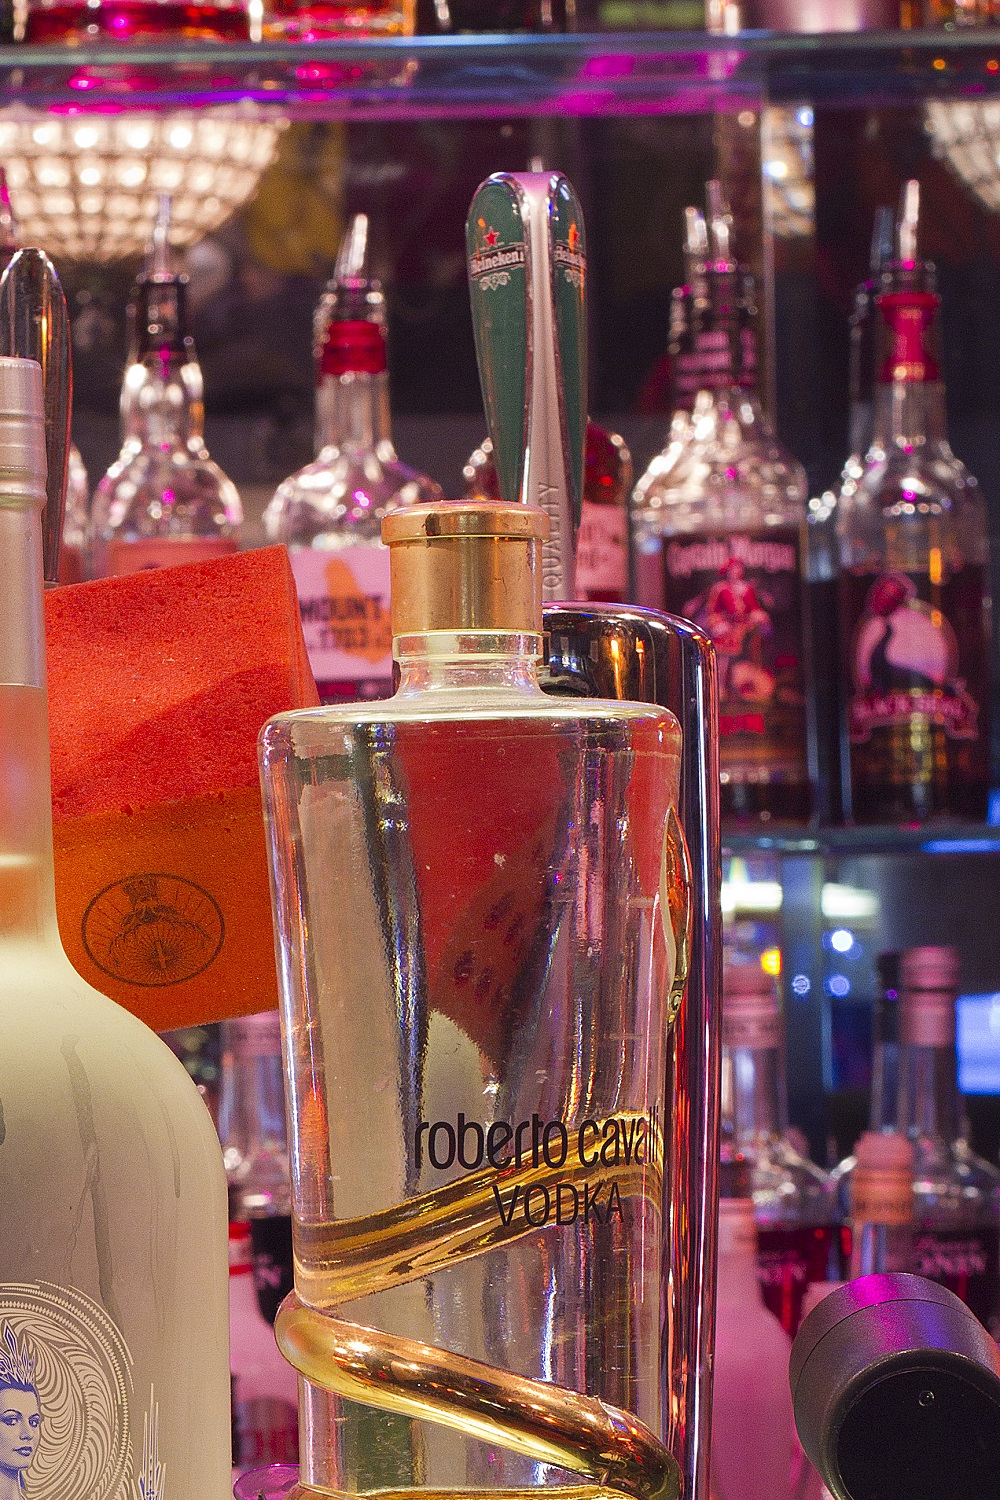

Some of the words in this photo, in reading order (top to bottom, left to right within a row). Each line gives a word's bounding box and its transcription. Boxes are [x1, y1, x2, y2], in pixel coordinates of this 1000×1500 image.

[538, 482, 562, 589] QUALITY
[414, 1113, 568, 1170] roberto
[492, 1181, 625, 1227] VODKA
